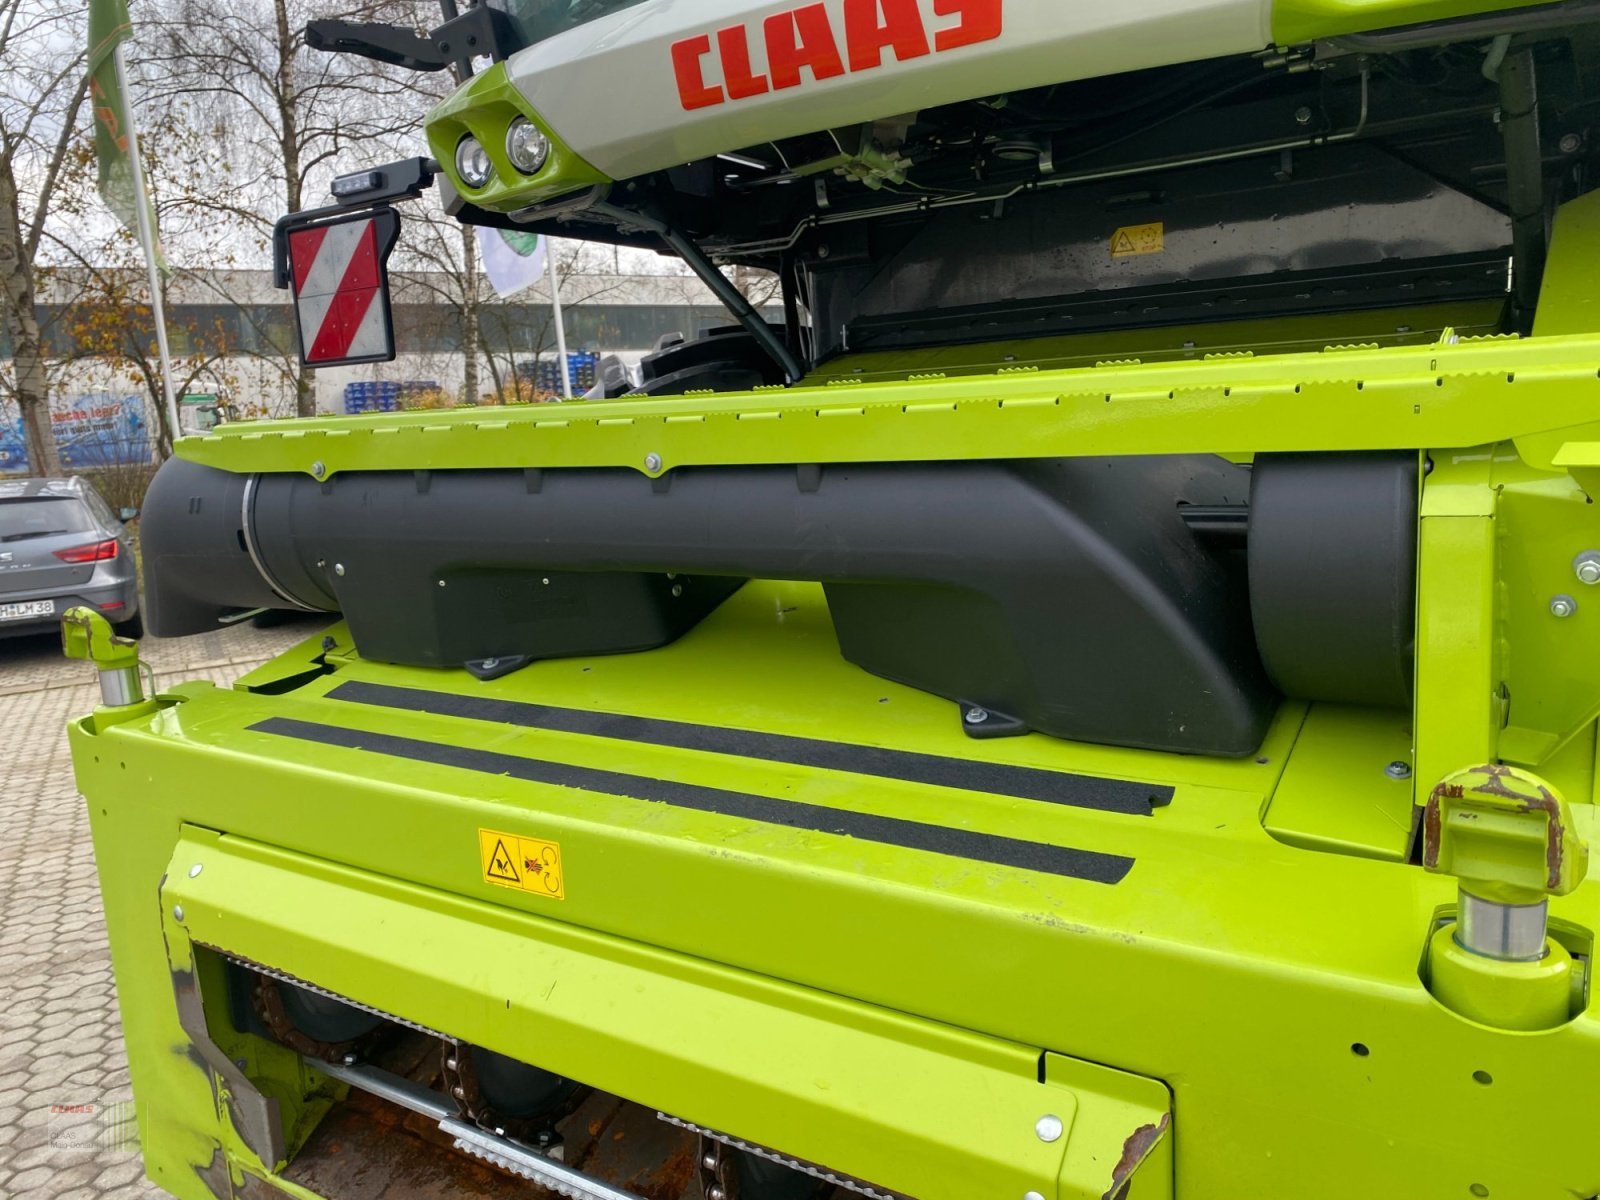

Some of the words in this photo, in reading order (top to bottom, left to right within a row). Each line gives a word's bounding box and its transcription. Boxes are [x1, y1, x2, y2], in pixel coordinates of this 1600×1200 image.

[670, 0, 1003, 111] CLAAS
[16, 603, 34, 615] LM
[36, 602, 51, 613] 38
